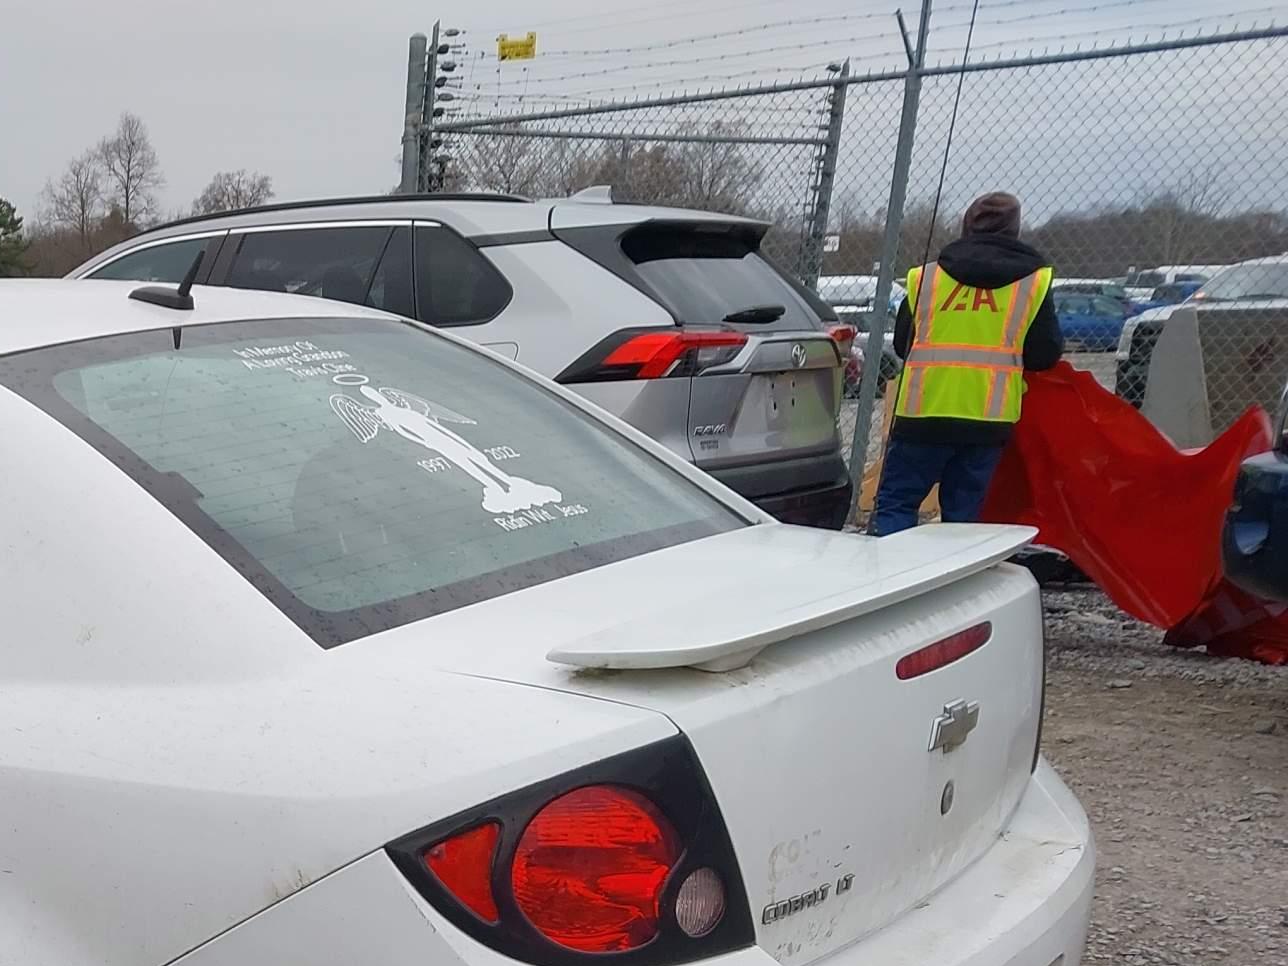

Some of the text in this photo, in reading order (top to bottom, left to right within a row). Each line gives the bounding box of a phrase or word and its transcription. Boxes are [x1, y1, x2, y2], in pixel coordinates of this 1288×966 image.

[483, 445, 521, 461] 2022
[416, 456, 452, 473] 1997
[762, 873, 855, 924] COBALT LT
